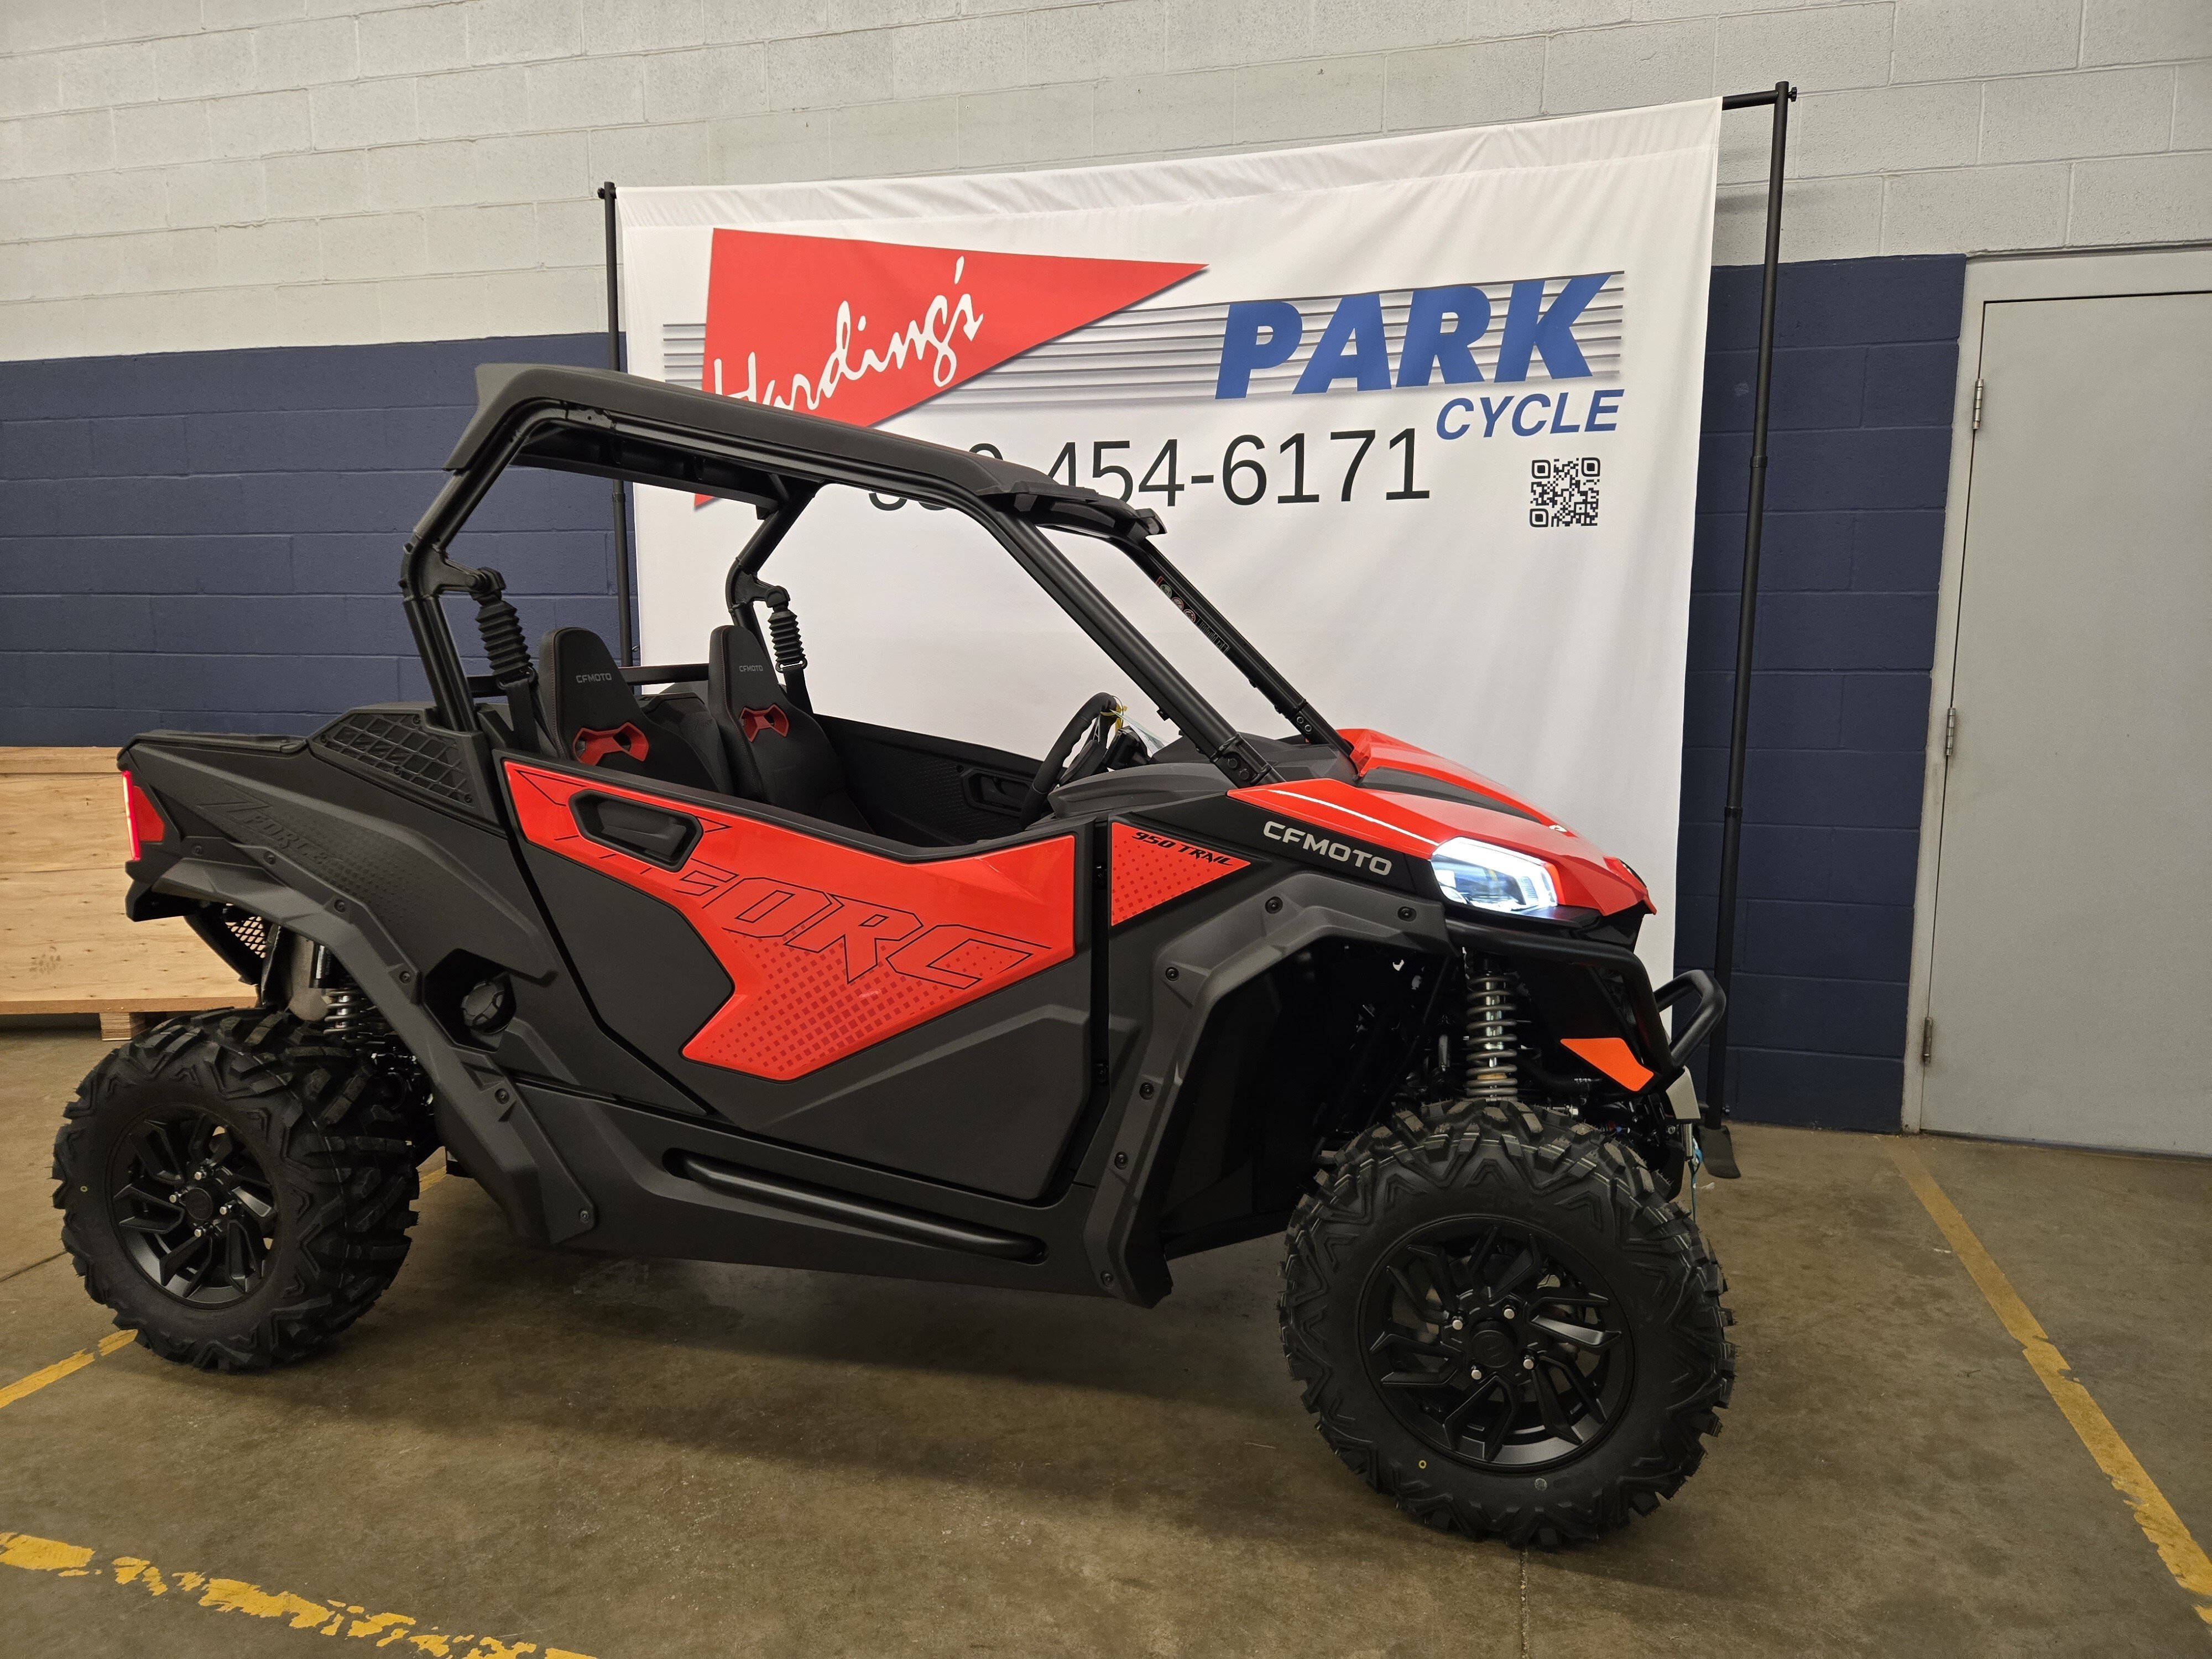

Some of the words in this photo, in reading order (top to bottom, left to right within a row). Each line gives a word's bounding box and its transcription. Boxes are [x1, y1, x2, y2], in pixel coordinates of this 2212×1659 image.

[1214, 275, 1612, 399] PARK
[1436, 388, 1625, 440] CYCLE
[576, 673, 612, 683] CFMOTO
[1131, 832, 1176, 848] 950
[1177, 844, 1233, 866] TRAIL
[1263, 821, 1392, 875] CFMOTO
